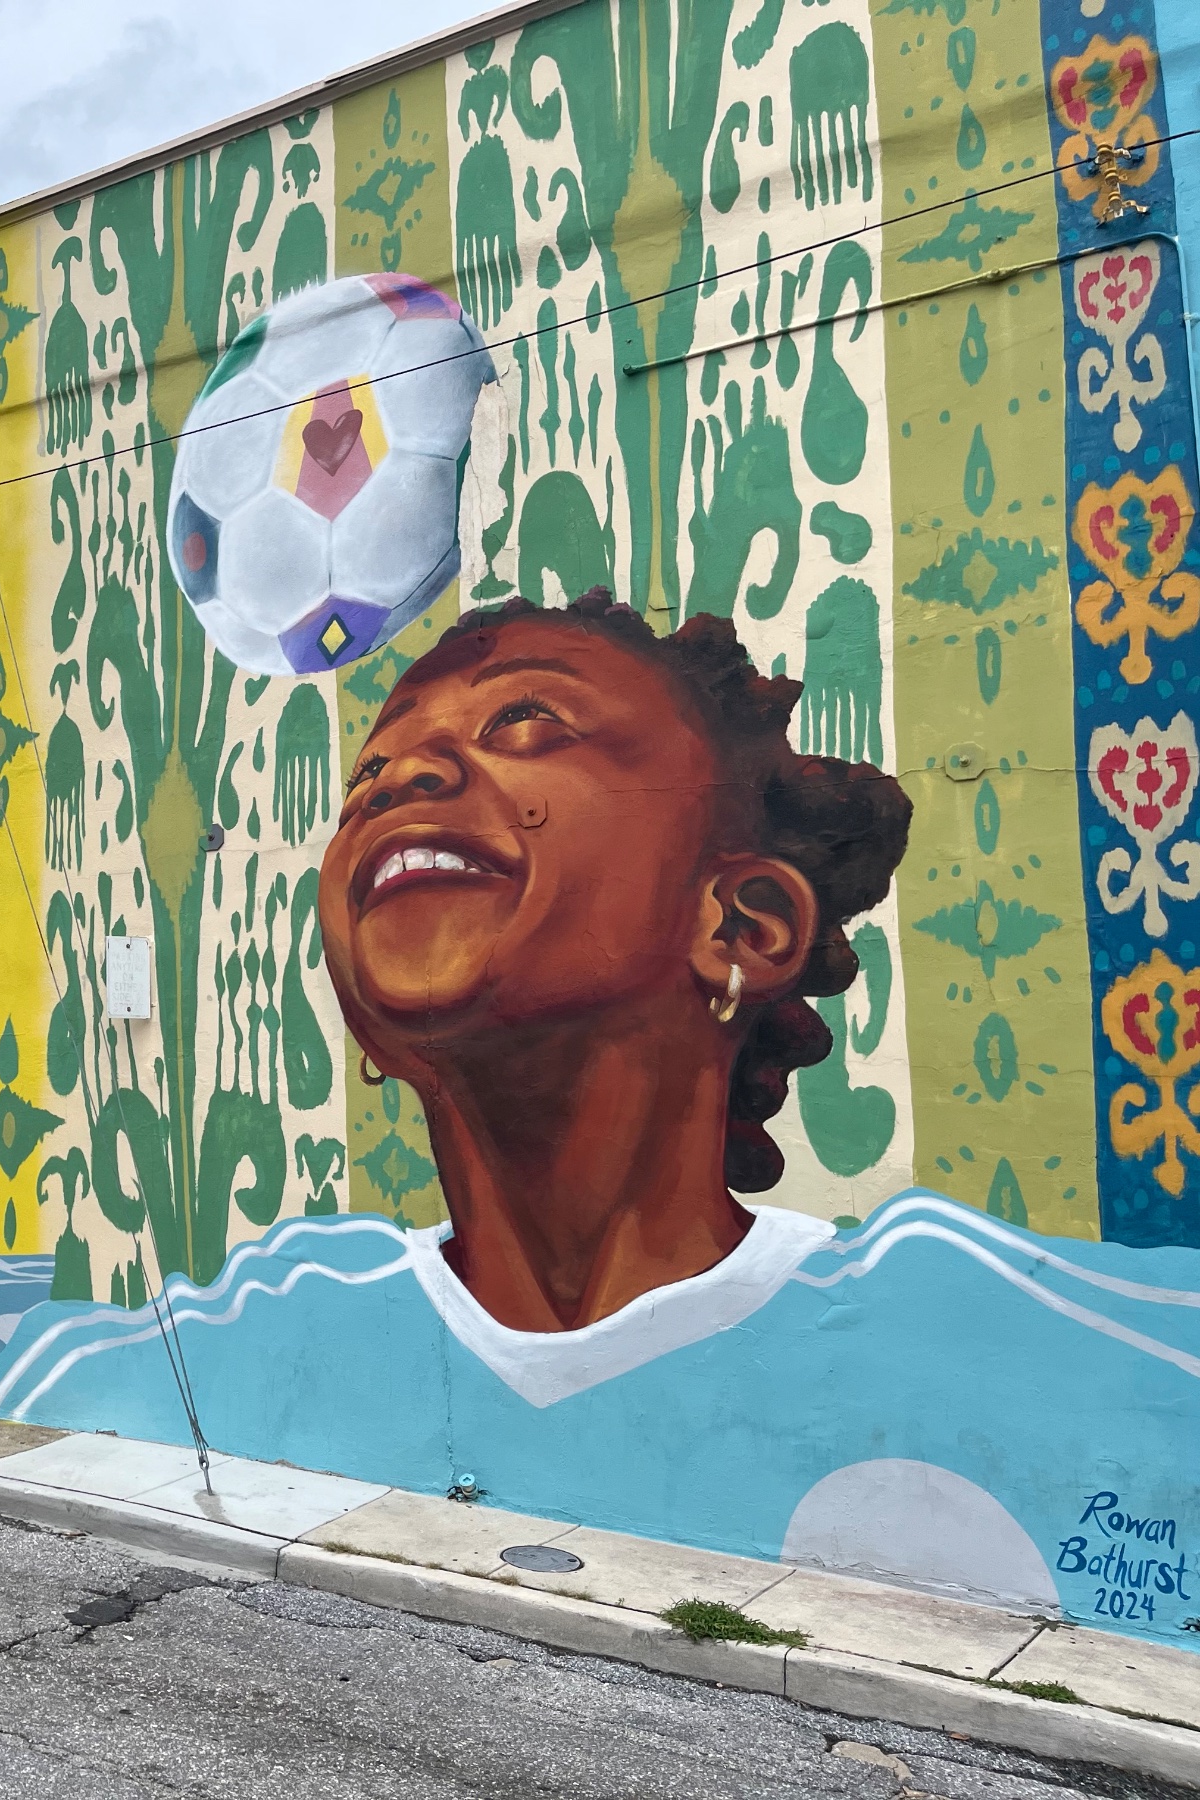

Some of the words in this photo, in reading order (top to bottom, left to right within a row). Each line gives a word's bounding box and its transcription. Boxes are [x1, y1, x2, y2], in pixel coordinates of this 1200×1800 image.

[1079, 1491, 1176, 1549] Rowan
[1056, 1536, 1191, 1600] Bathurst
[1094, 1588, 1156, 1621] 2024
